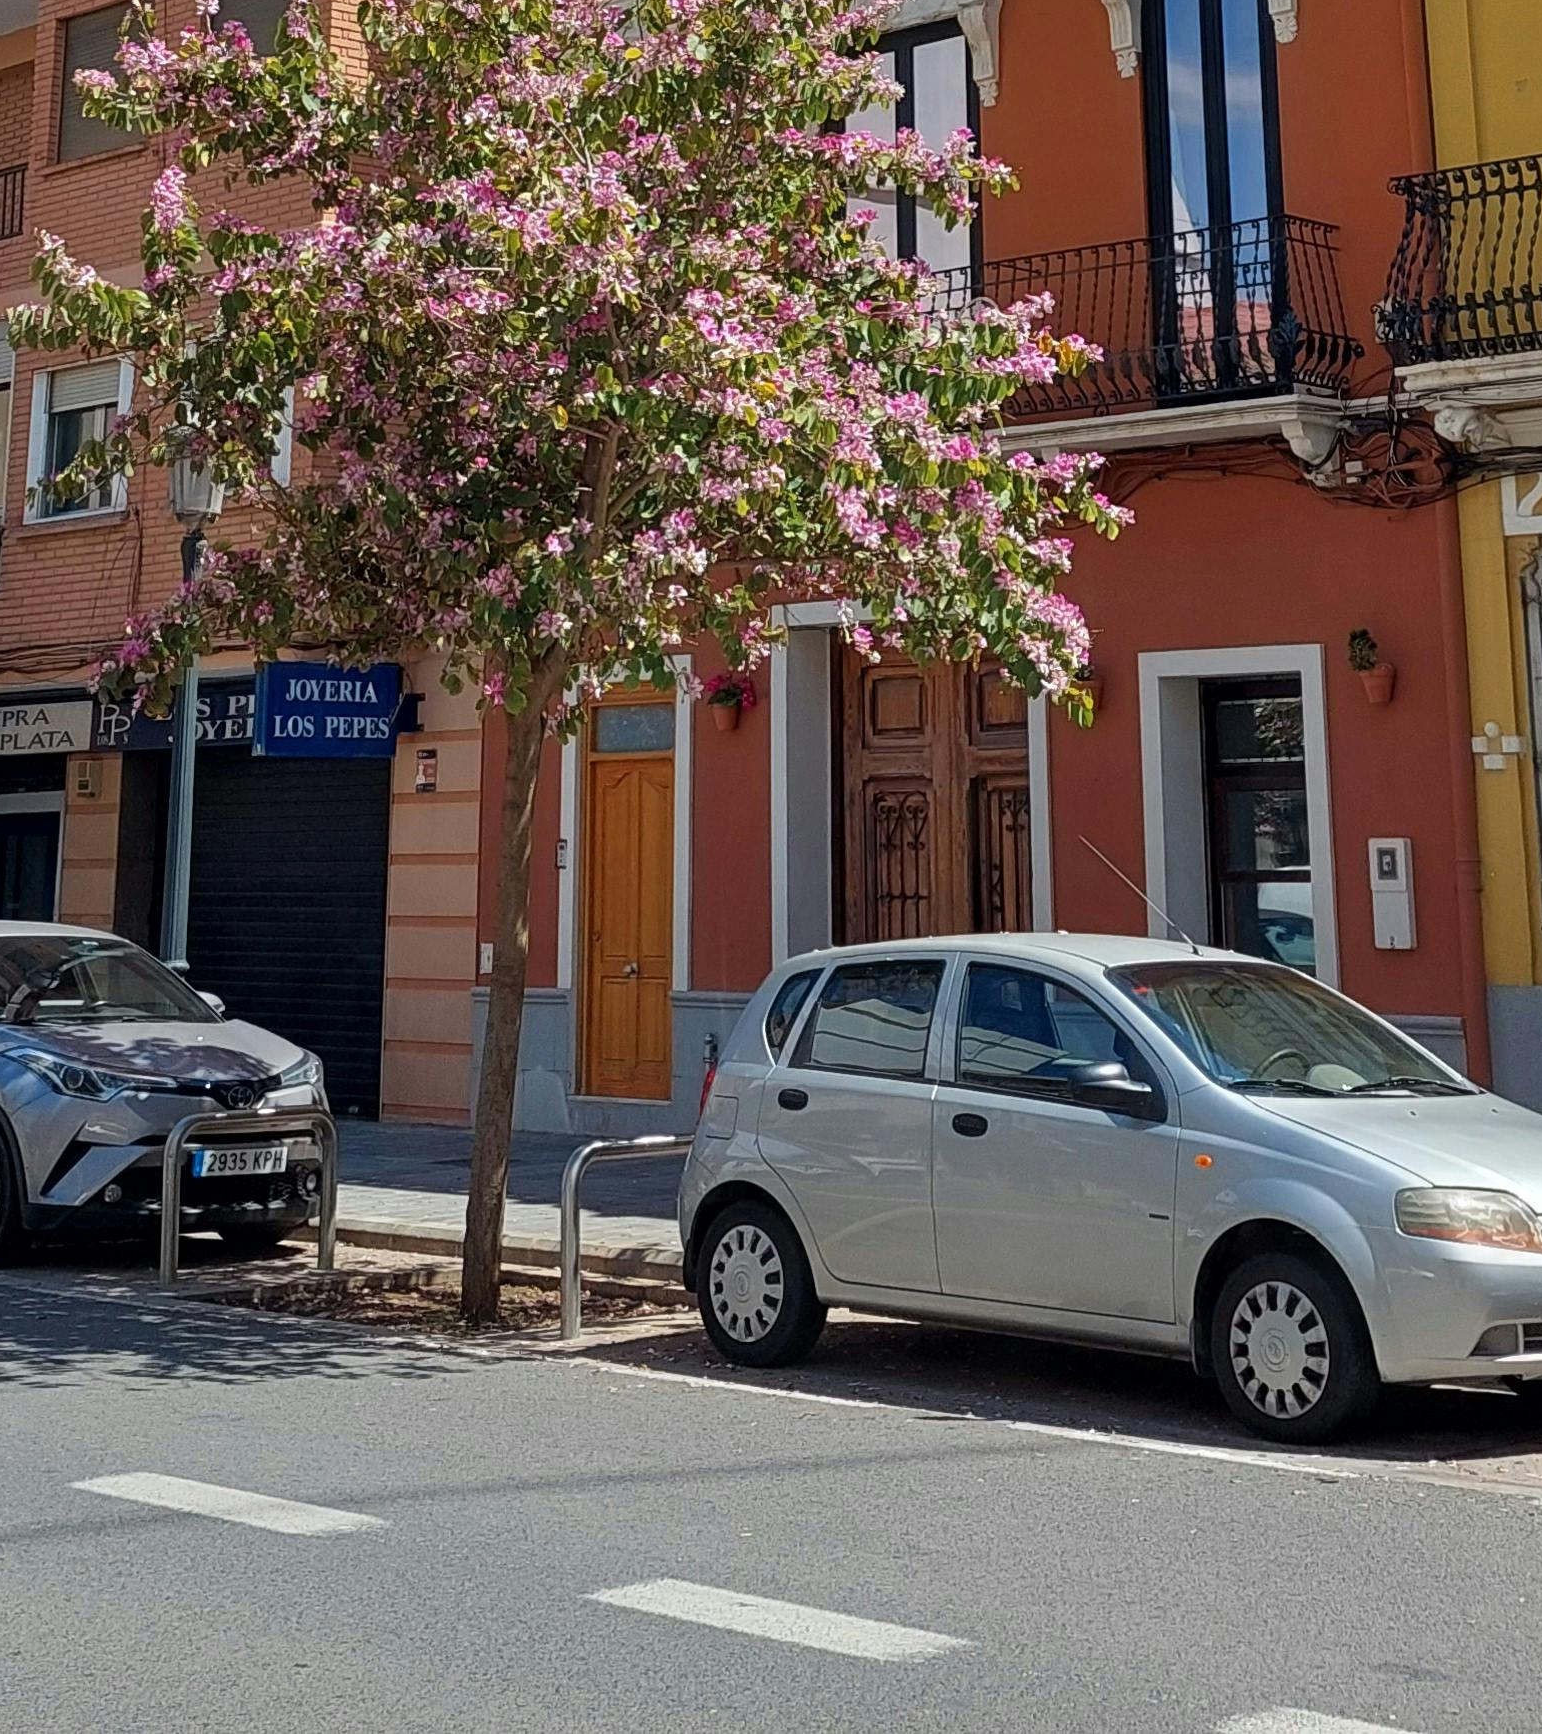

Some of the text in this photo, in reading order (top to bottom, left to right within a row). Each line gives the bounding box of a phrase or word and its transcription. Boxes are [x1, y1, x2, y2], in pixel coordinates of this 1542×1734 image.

[285, 678, 379, 703] JOYERIA
[273, 715, 390, 739] LOS PEPES
[0, 730, 75, 751] PLATA
[207, 1150, 284, 1172] 2935 KPH
